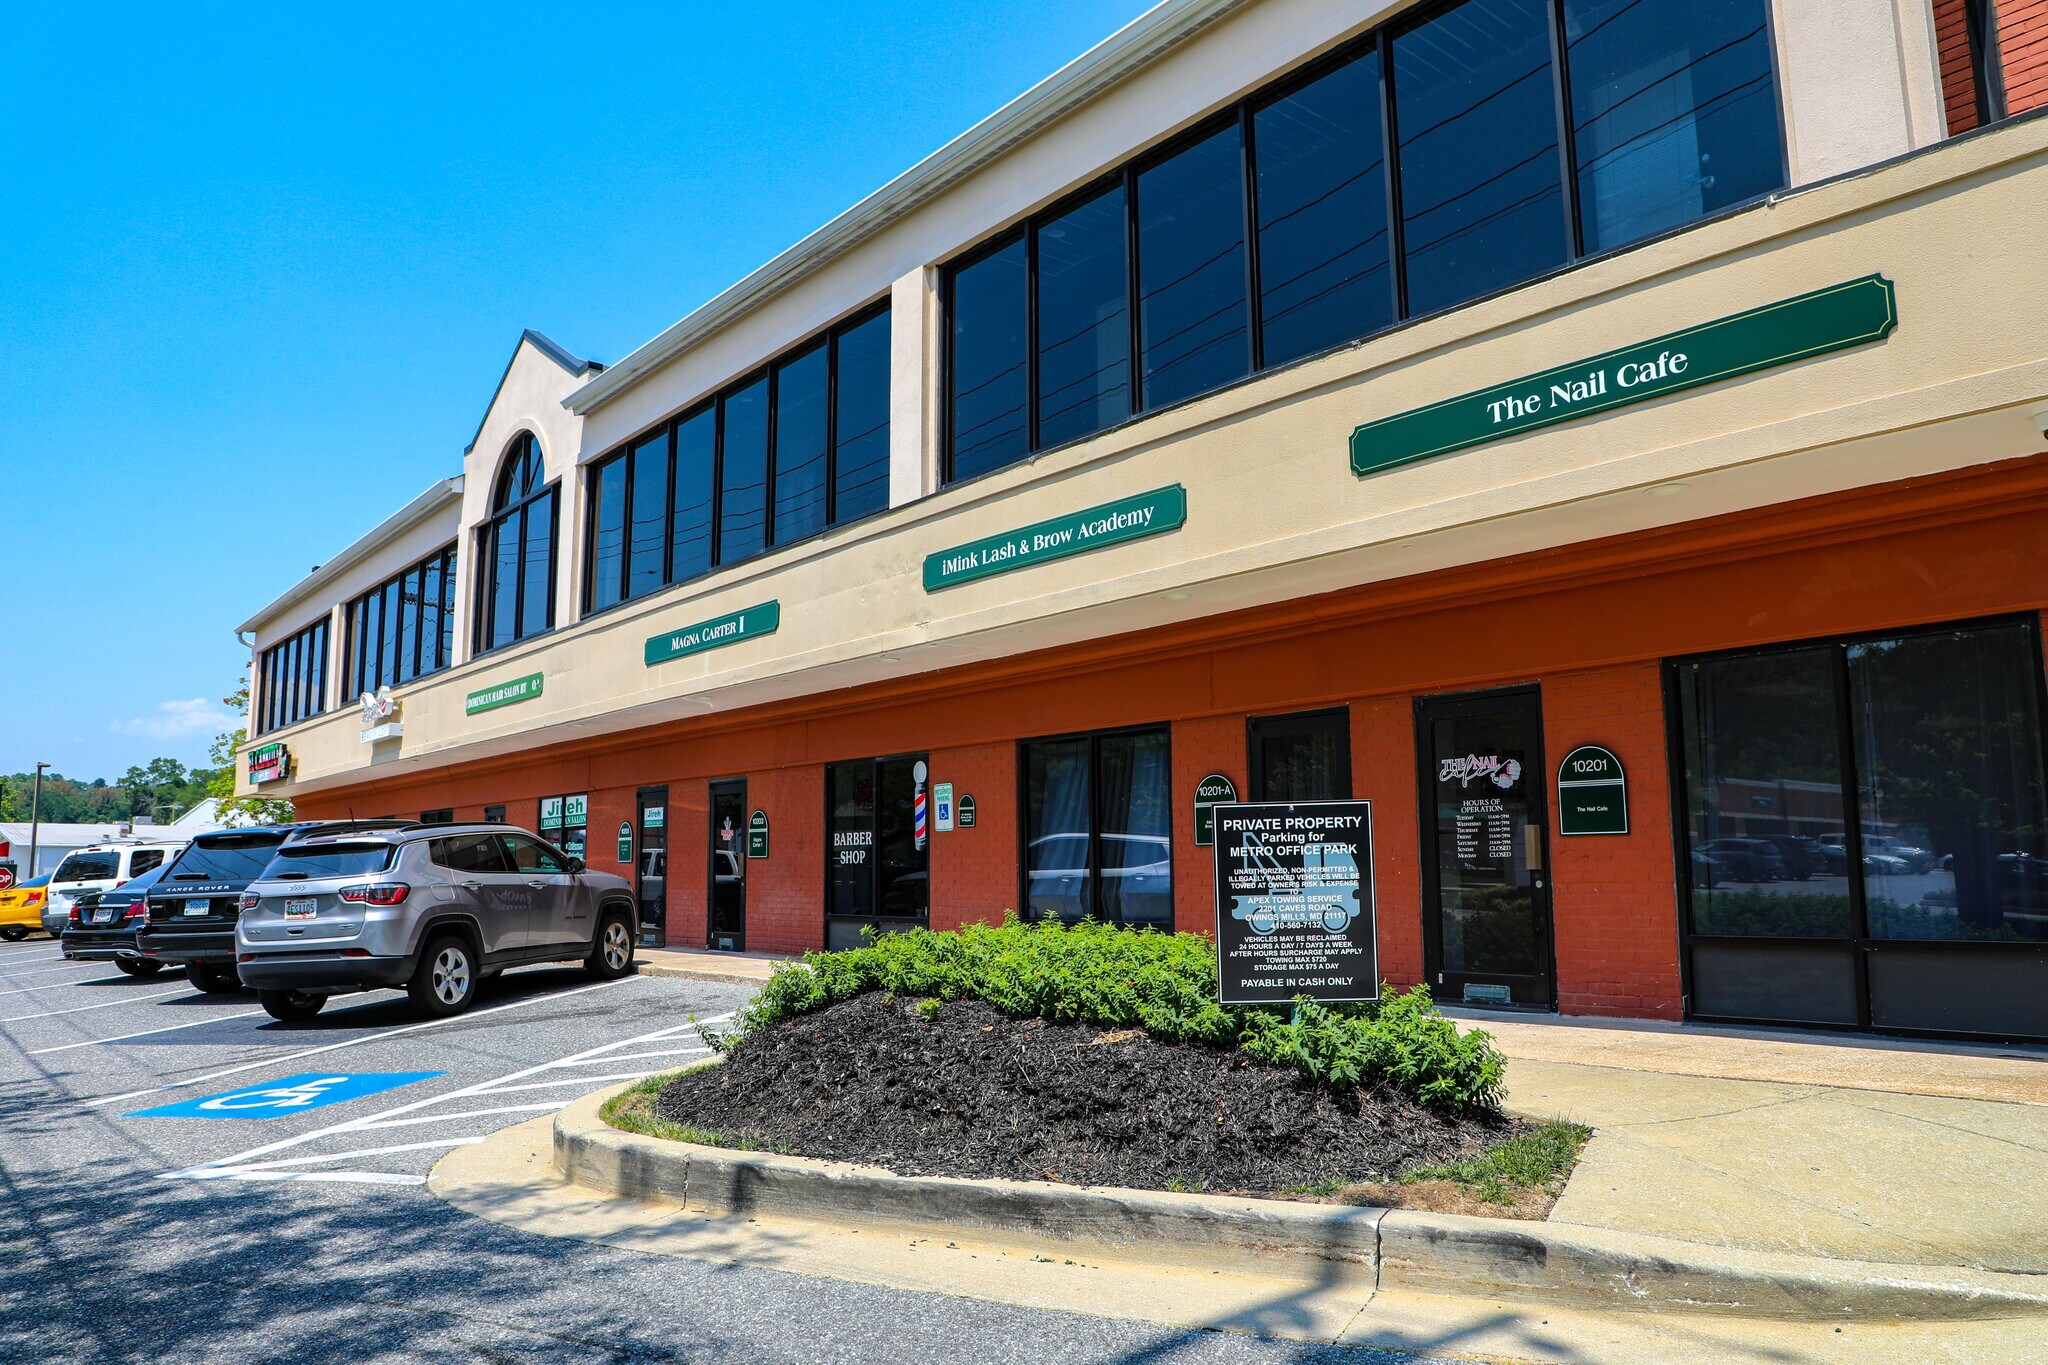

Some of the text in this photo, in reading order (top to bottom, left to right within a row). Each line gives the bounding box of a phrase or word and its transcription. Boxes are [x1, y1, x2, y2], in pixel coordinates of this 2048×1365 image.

[1487, 350, 1688, 424] The Nail Cafe
[942, 505, 1155, 575] iMink Lash & Brow Academy
[671, 632, 700, 651] MAGNA
[702, 621, 736, 642] CARTER
[1473, 755, 1500, 770] NAIL
[1572, 759, 1607, 772] 10201
[1199, 786, 1231, 796] 10201-A
[1460, 805, 1503, 813] OPERATION
[1223, 816, 1362, 831] PRIVATE PROPERTY
[834, 832, 872, 846] BARBER
[1261, 832, 1325, 844] Parking for
[1230, 843, 1357, 857] METRO OFFICE PARK
[840, 850, 866, 864] SHOP
[1233, 867, 1290, 875] UNAUTHORIZED,
[1248, 896, 1271, 904] APEX
[1278, 904, 1307, 912] CAVES
[1245, 912, 1346, 921] OWINGS MILLS, MD 21117
[1244, 935, 1279, 943] VEHICLES
[1241, 976, 1354, 988] PAYABLE IN CASH ONLY
